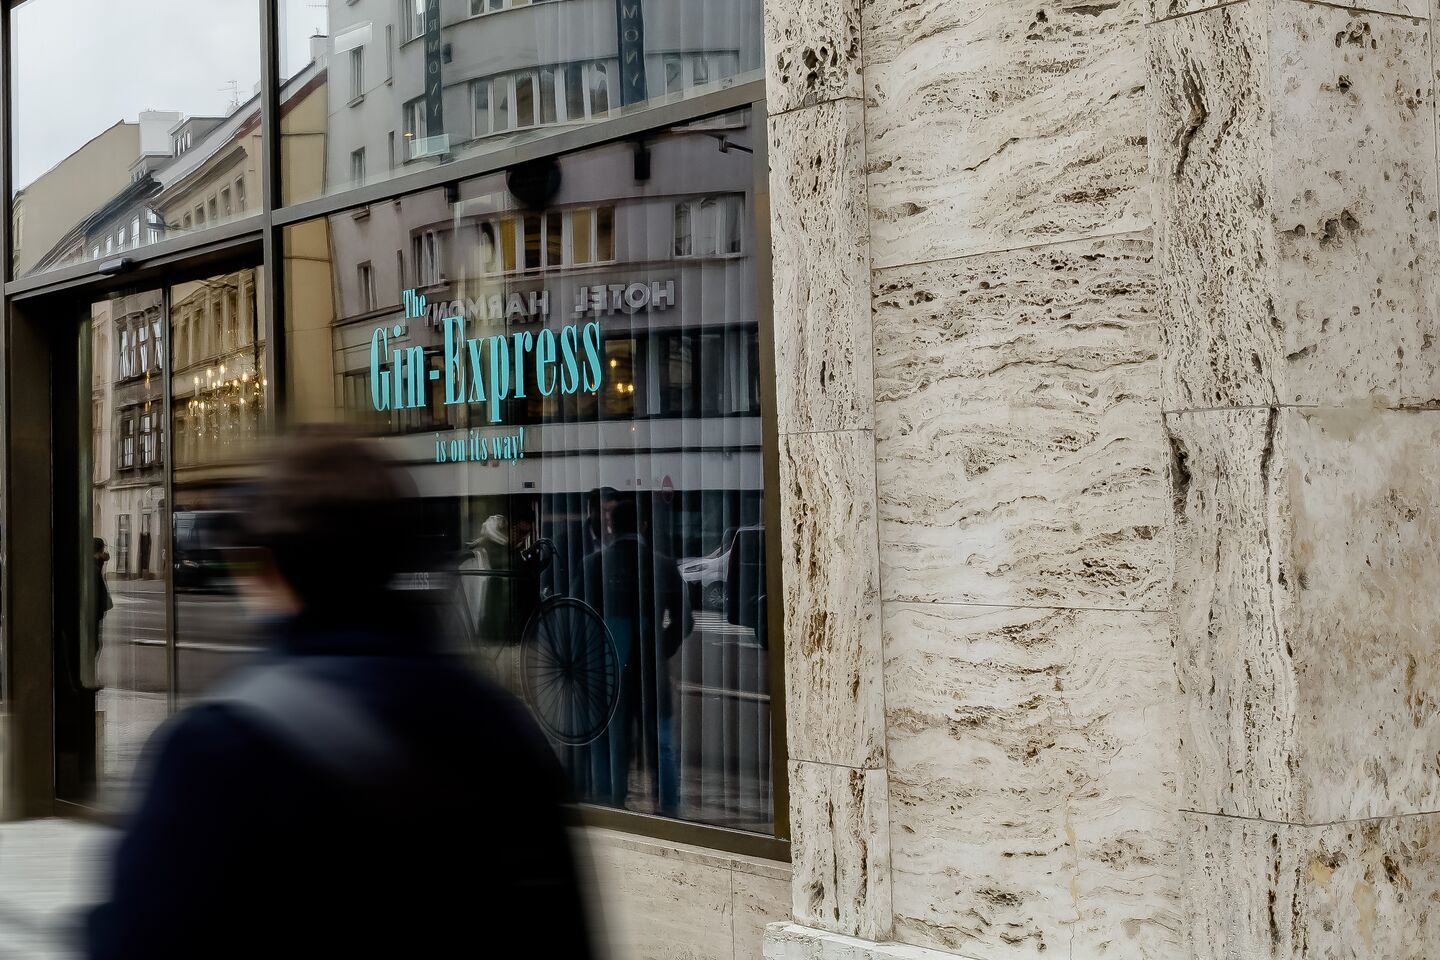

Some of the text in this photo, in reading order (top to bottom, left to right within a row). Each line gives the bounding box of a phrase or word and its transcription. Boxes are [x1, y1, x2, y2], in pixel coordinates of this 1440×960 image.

[402, 288, 427, 319] The
[370, 315, 602, 424] Gin-Express
[435, 426, 525, 466] is on its way!
